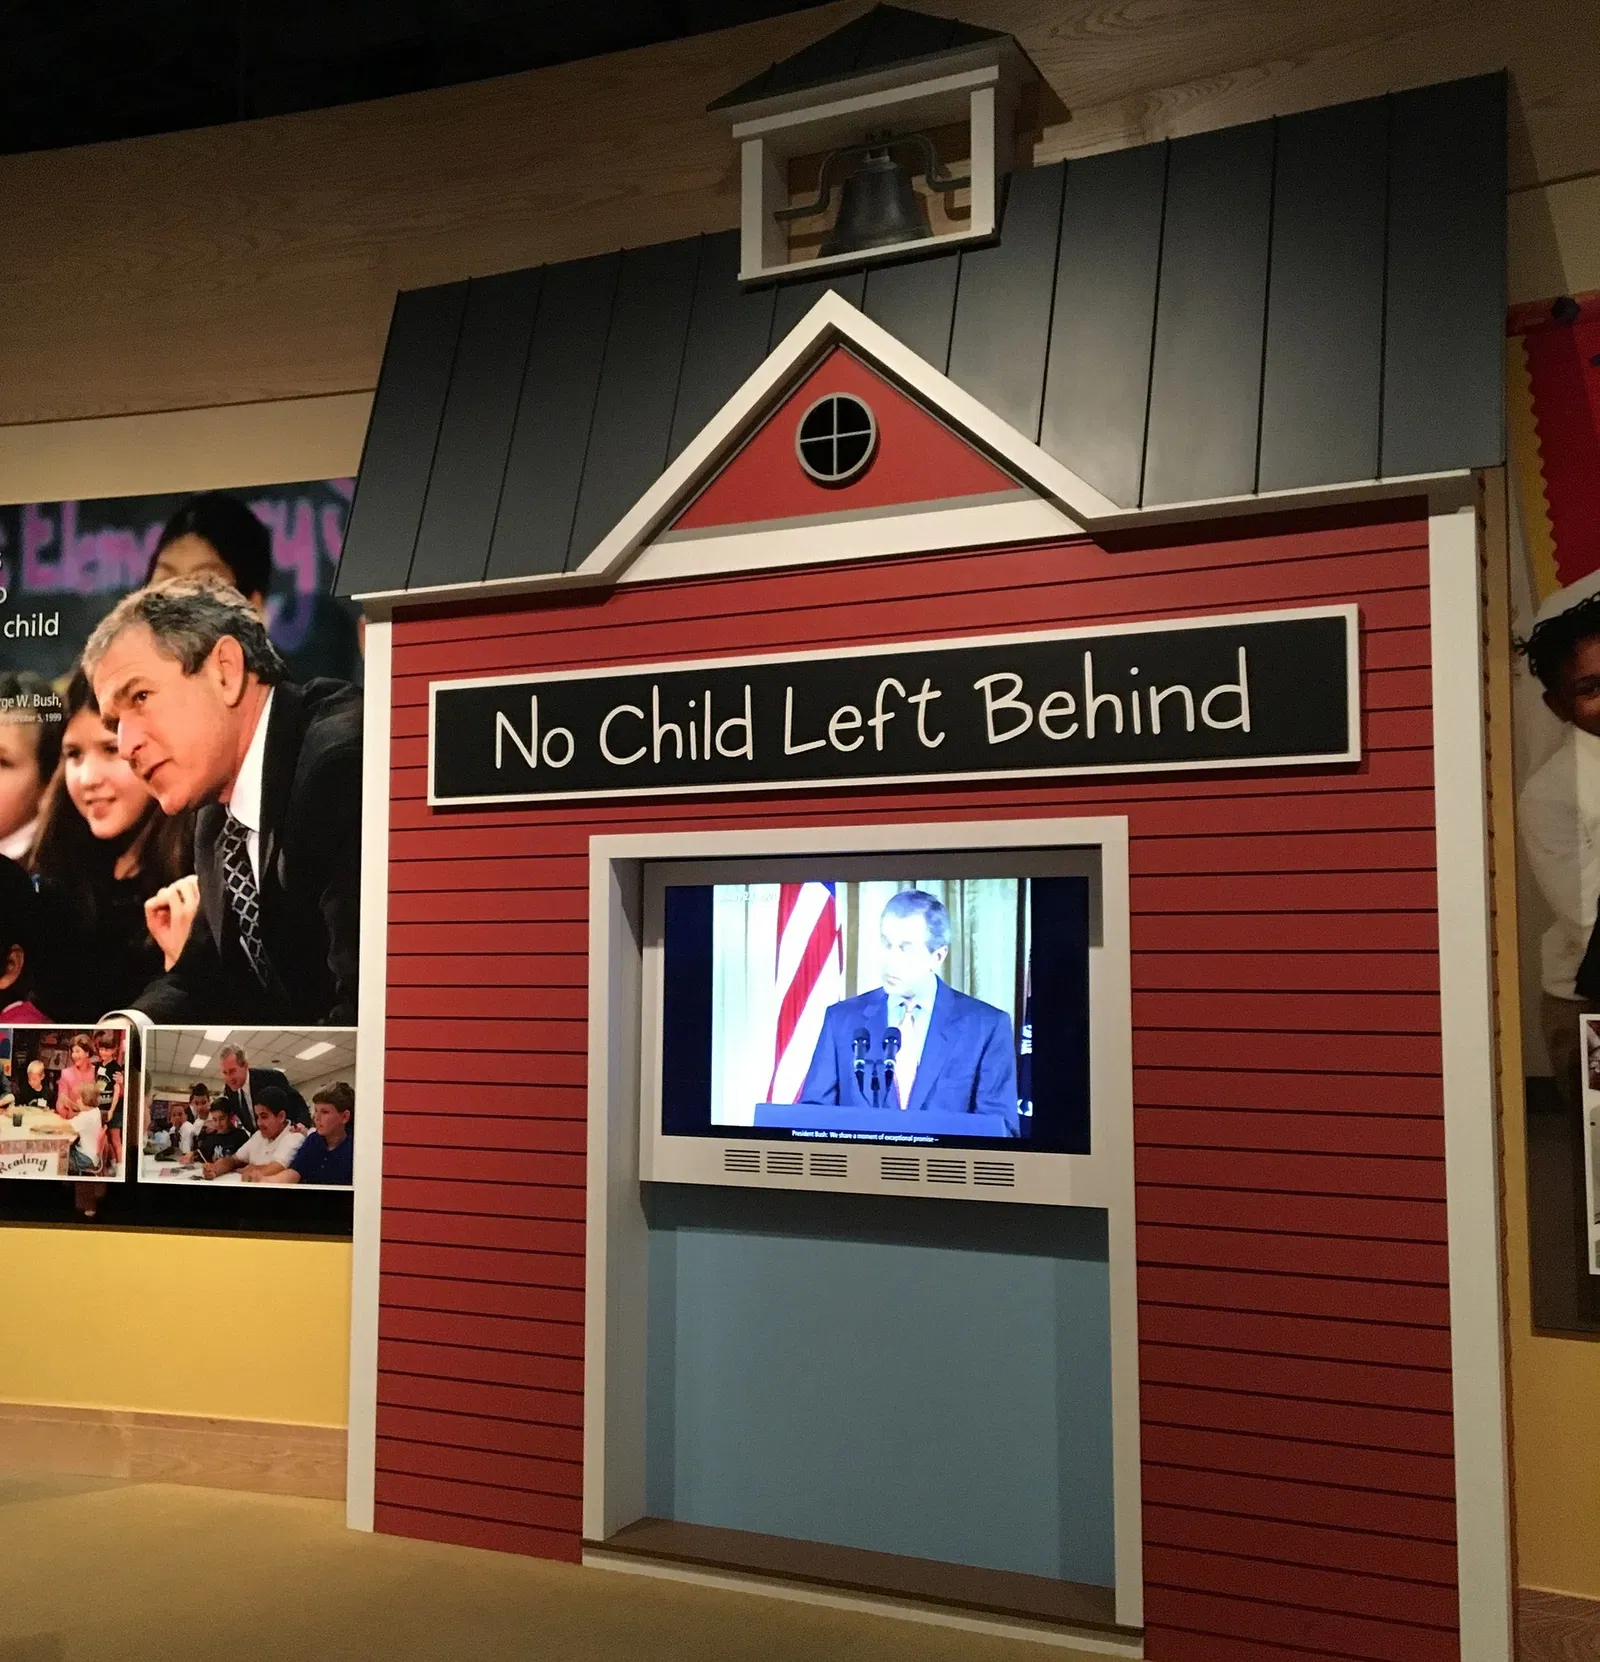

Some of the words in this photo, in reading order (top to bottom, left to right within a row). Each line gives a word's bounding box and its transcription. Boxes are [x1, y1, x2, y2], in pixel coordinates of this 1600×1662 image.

[3, 611, 60, 638] child
[16, 694, 30, 708] W.
[33, 692, 62, 708] Bush,
[495, 694, 575, 769] No
[600, 684, 754, 765] Child
[784, 677, 946, 756] Left
[973, 644, 1251, 746] Behind
[45, 713, 62, 722] 1999
[791, 1130, 814, 1138] President
[838, 1132, 853, 1140] share
[857, 1133, 878, 1141] moment
[878, 1133, 885, 1141] of
[885, 1134, 913, 1142] exceptional
[0, 1154, 48, 1174] Reading
